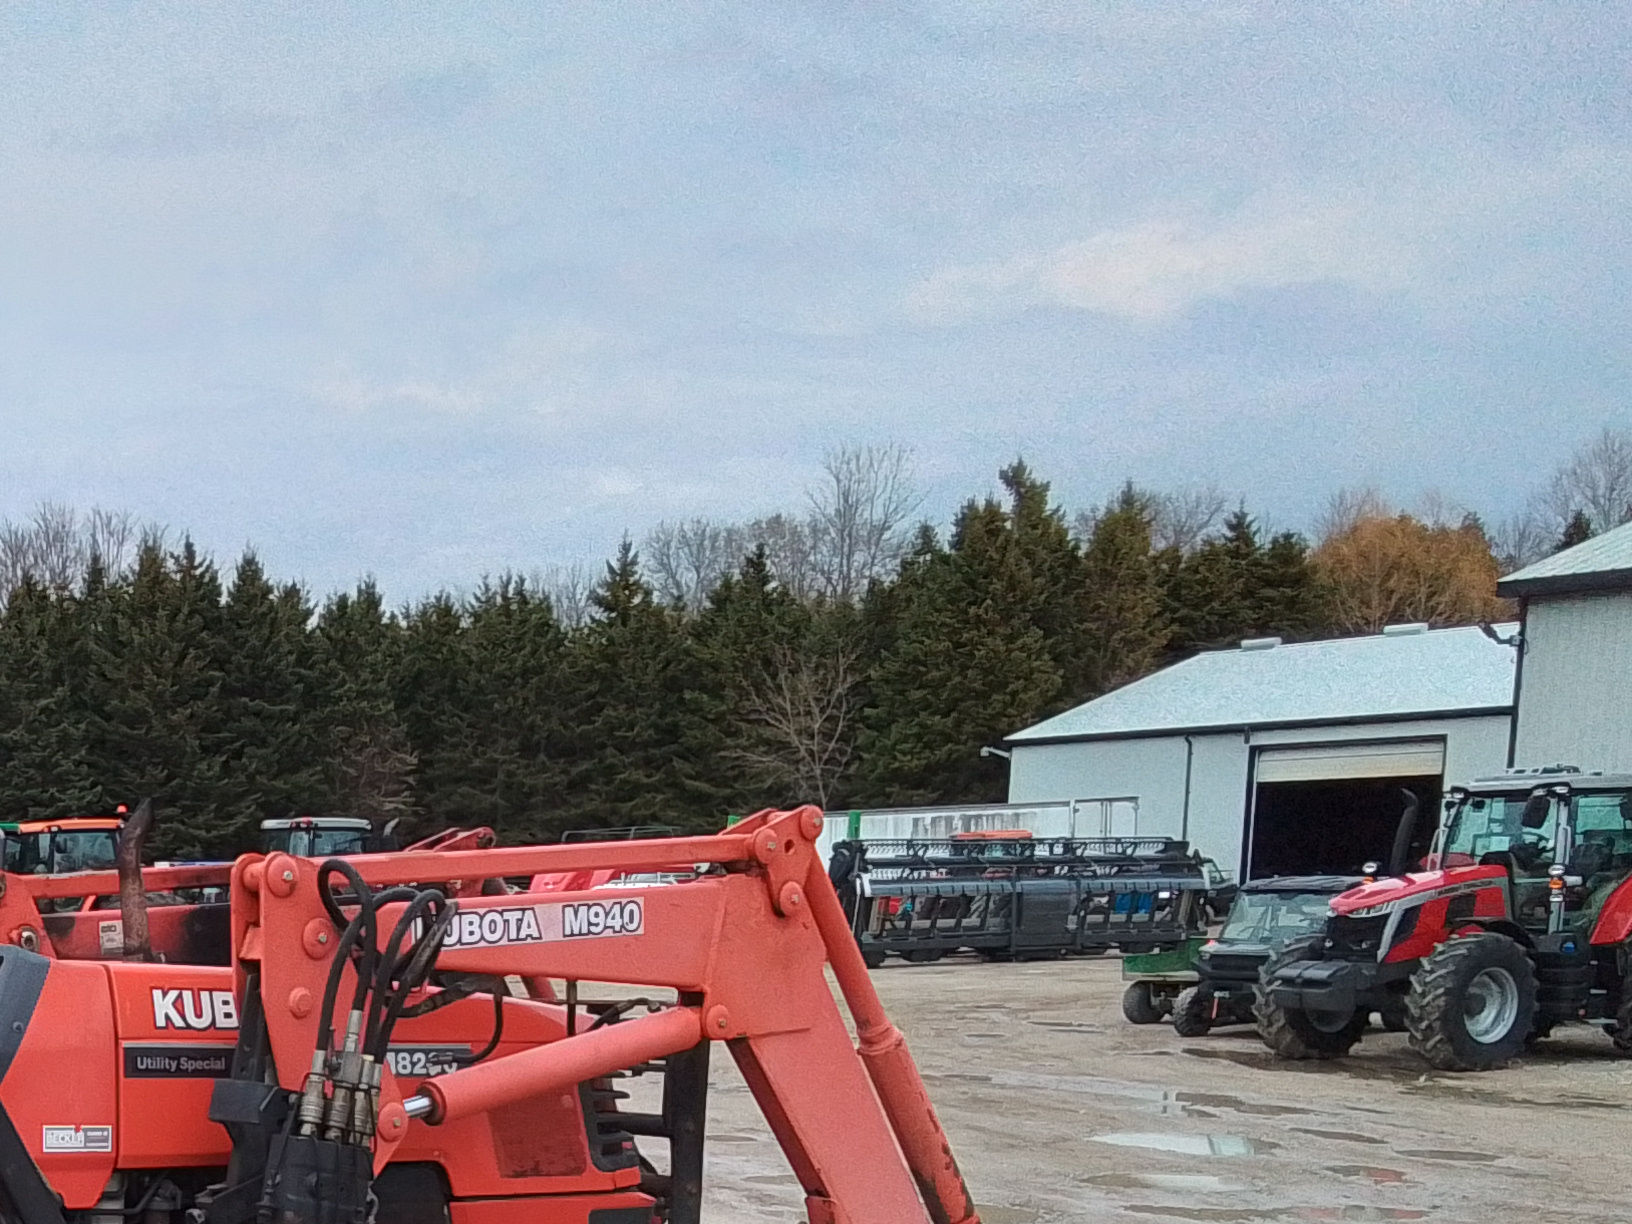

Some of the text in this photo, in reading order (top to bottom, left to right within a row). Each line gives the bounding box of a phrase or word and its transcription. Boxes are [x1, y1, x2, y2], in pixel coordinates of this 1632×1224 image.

[410, 899, 643, 949] UBOTA M940
[151, 986, 241, 1030] KUB
[136, 1055, 226, 1073] Utility Special
